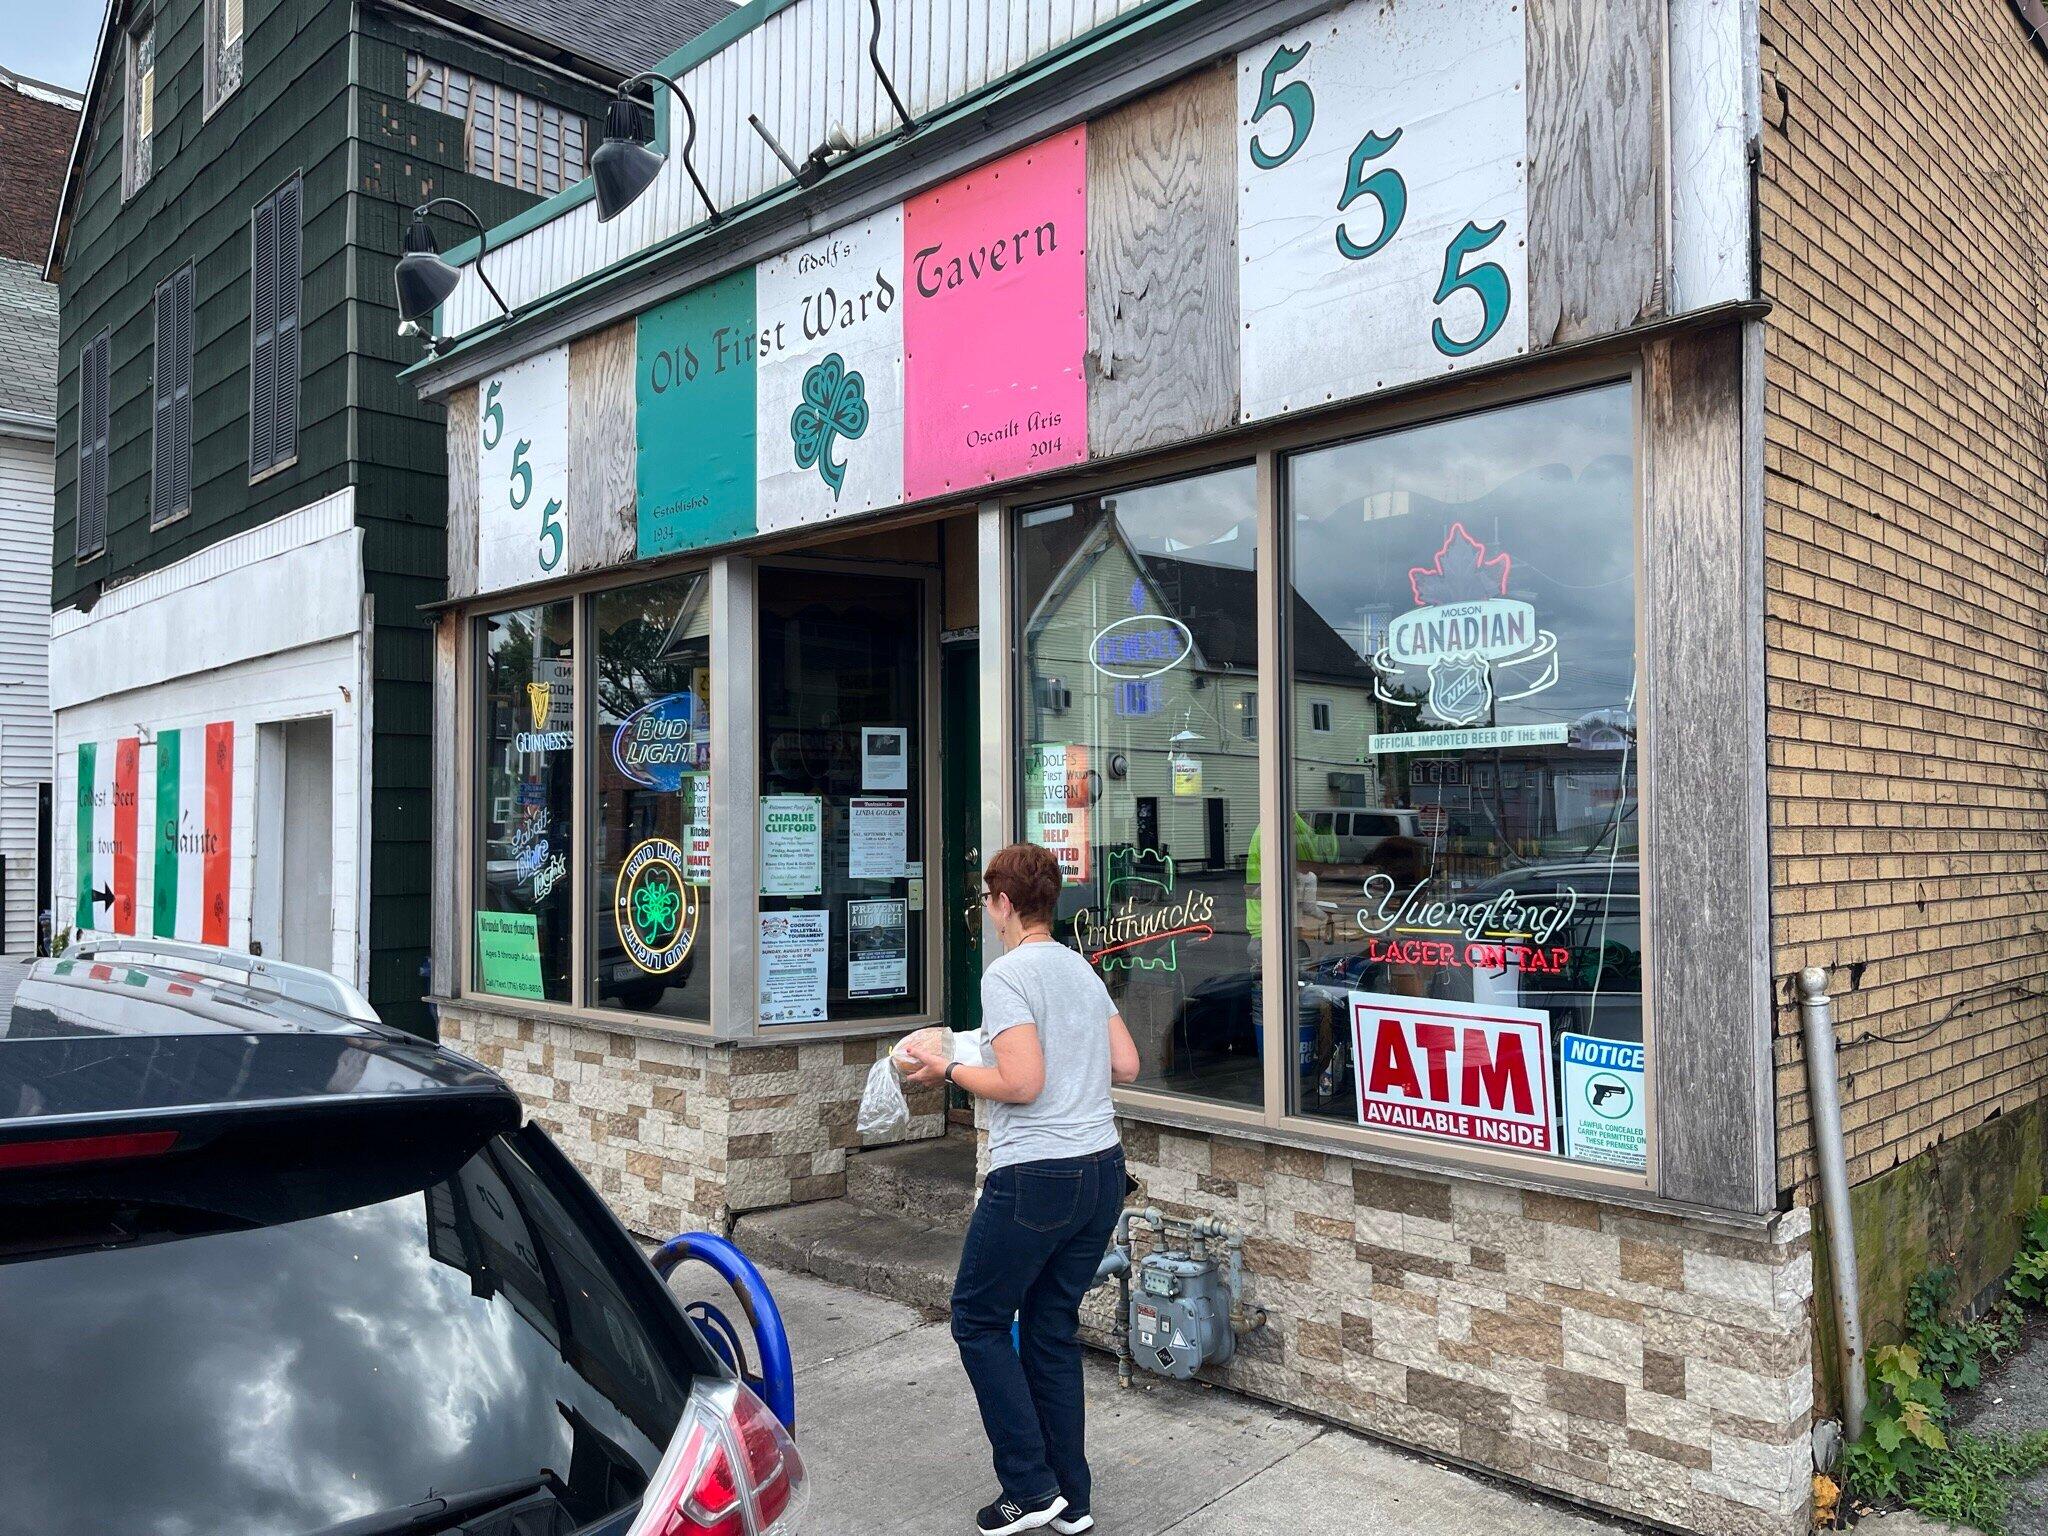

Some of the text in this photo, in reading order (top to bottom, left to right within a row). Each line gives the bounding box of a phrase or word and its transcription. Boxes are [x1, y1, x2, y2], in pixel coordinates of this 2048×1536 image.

[1250, 40, 1511, 357] 5 5 5
[799, 240, 851, 275] Adolf's
[651, 222, 1057, 394] Old First Ward Tavern
[1031, 437, 1062, 458] 2014
[483, 380, 564, 571] 5 5 5
[653, 495, 709, 519] Established
[653, 526, 674, 543] 1934
[1441, 606, 1482, 618] MOLSON
[1396, 611, 1525, 655] CANADIAN
[1447, 674, 1474, 705] NHL
[637, 717, 687, 741] BUD
[1374, 736, 1415, 749] OFFICIAL
[1419, 733, 1467, 746] IMPORTED
[1472, 731, 1497, 744] BEER
[1501, 730, 1513, 742] OF
[1517, 729, 1535, 741] THE
[516, 732, 569, 753] GUINNESS
[626, 742, 697, 764] LIGHT
[79, 782, 134, 807] Coldest Beer
[765, 823, 817, 833] CLIFFORD
[768, 813, 815, 823] CHARLIE
[1038, 811, 1073, 824] Kitchen
[165, 808, 218, 855] Sláinte
[1043, 829, 1069, 842] HELP
[86, 835, 123, 854] in town
[693, 841, 710, 851] HELP
[627, 844, 655, 879] BUD
[687, 856, 710, 866] WANTE
[851, 903, 903, 914] PREVENT
[1357, 873, 1577, 944] Yuengling
[624, 927, 691, 969] BUD LIGHT
[1369, 938, 1569, 973] LAGER ON TAP
[1571, 1041, 1644, 1069] NOTICE
[1369, 1018, 1535, 1116] ATM
[1367, 1103, 1545, 1147] AVAILABLE INSIDE
[1578, 1128, 1598, 1137] CARRY
[1599, 1131, 1636, 1143] PERMITTED
[1579, 1120, 1644, 1135] LAWFUL CONCEALED
[1586, 1137, 1604, 1146] THESE
[1606, 1140, 1639, 1152] PREMISES
